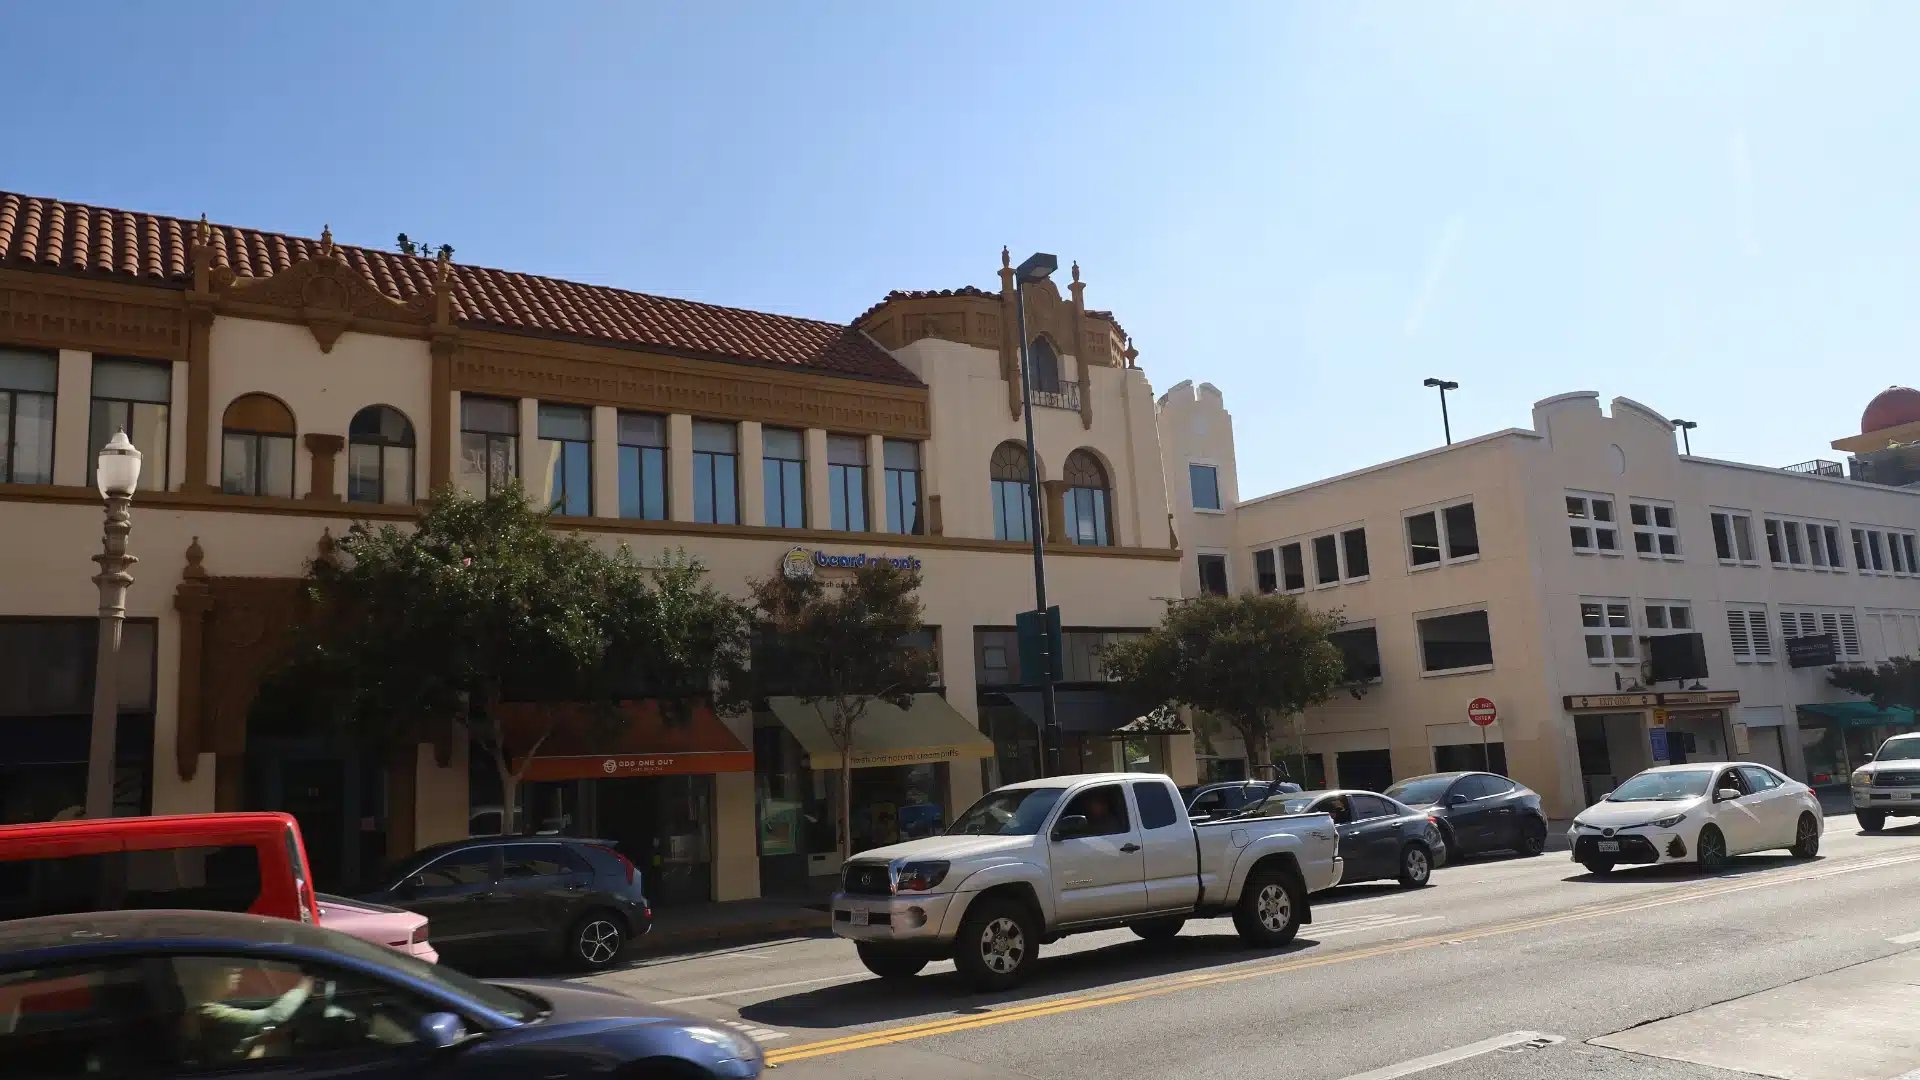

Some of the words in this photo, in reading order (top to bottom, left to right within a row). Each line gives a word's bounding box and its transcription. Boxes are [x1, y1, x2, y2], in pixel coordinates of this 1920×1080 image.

[816, 551, 866, 568] beard
[872, 754, 887, 763] and
[888, 751, 916, 763] natural
[940, 749, 959, 760] puffs
